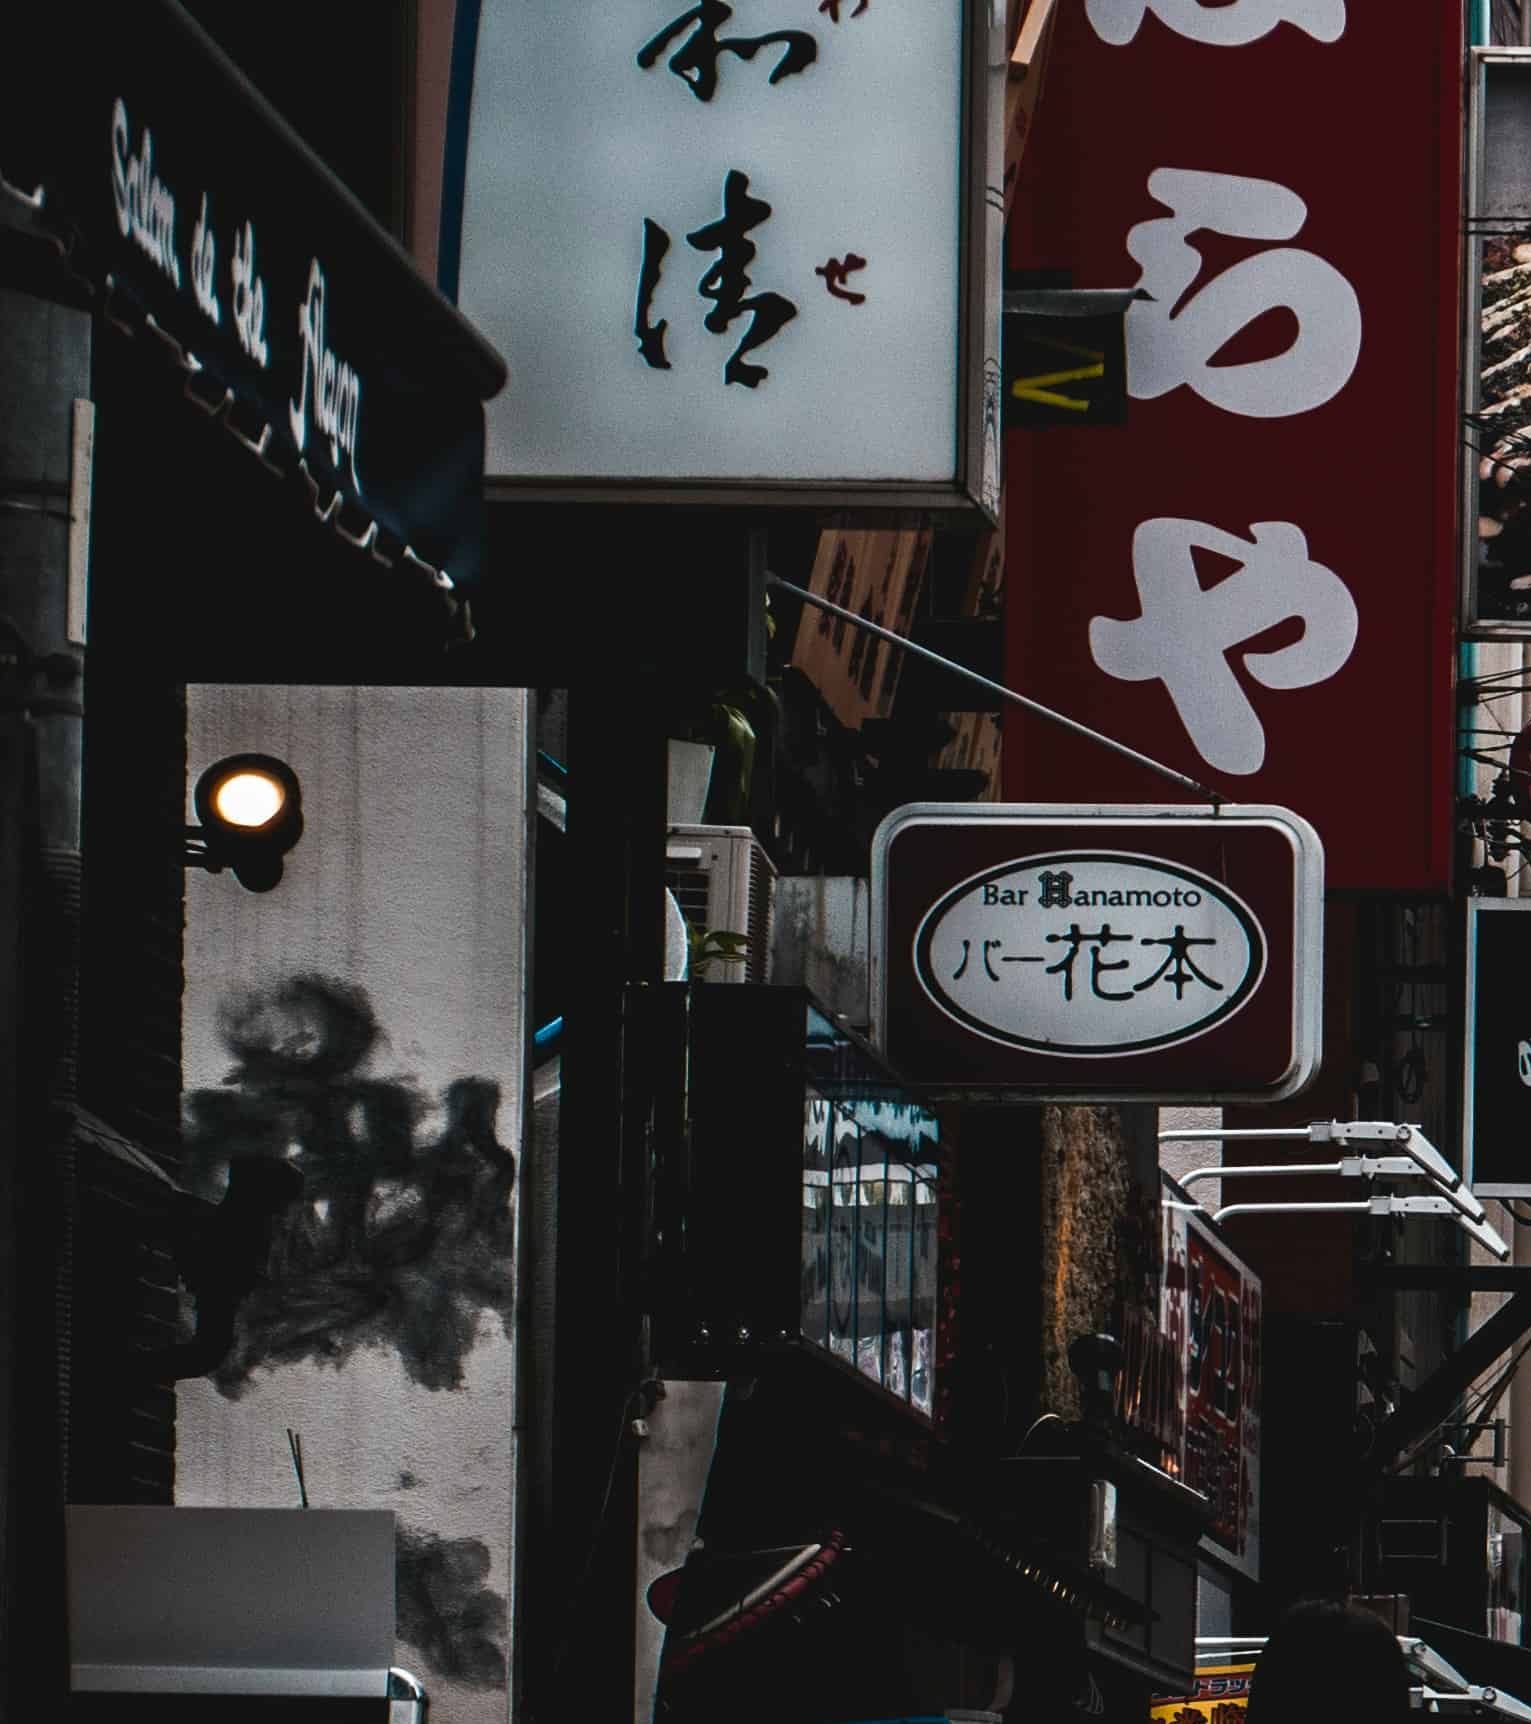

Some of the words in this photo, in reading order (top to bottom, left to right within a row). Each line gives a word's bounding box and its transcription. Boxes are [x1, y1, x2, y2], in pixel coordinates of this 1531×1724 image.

[191, 191, 221, 327] de
[1085, 0, 1361, 775] らや
[982, 885, 1028, 907] Bar
[1038, 870, 1202, 908] Hanamoto
[953, 924, 1224, 1001] バー花本
